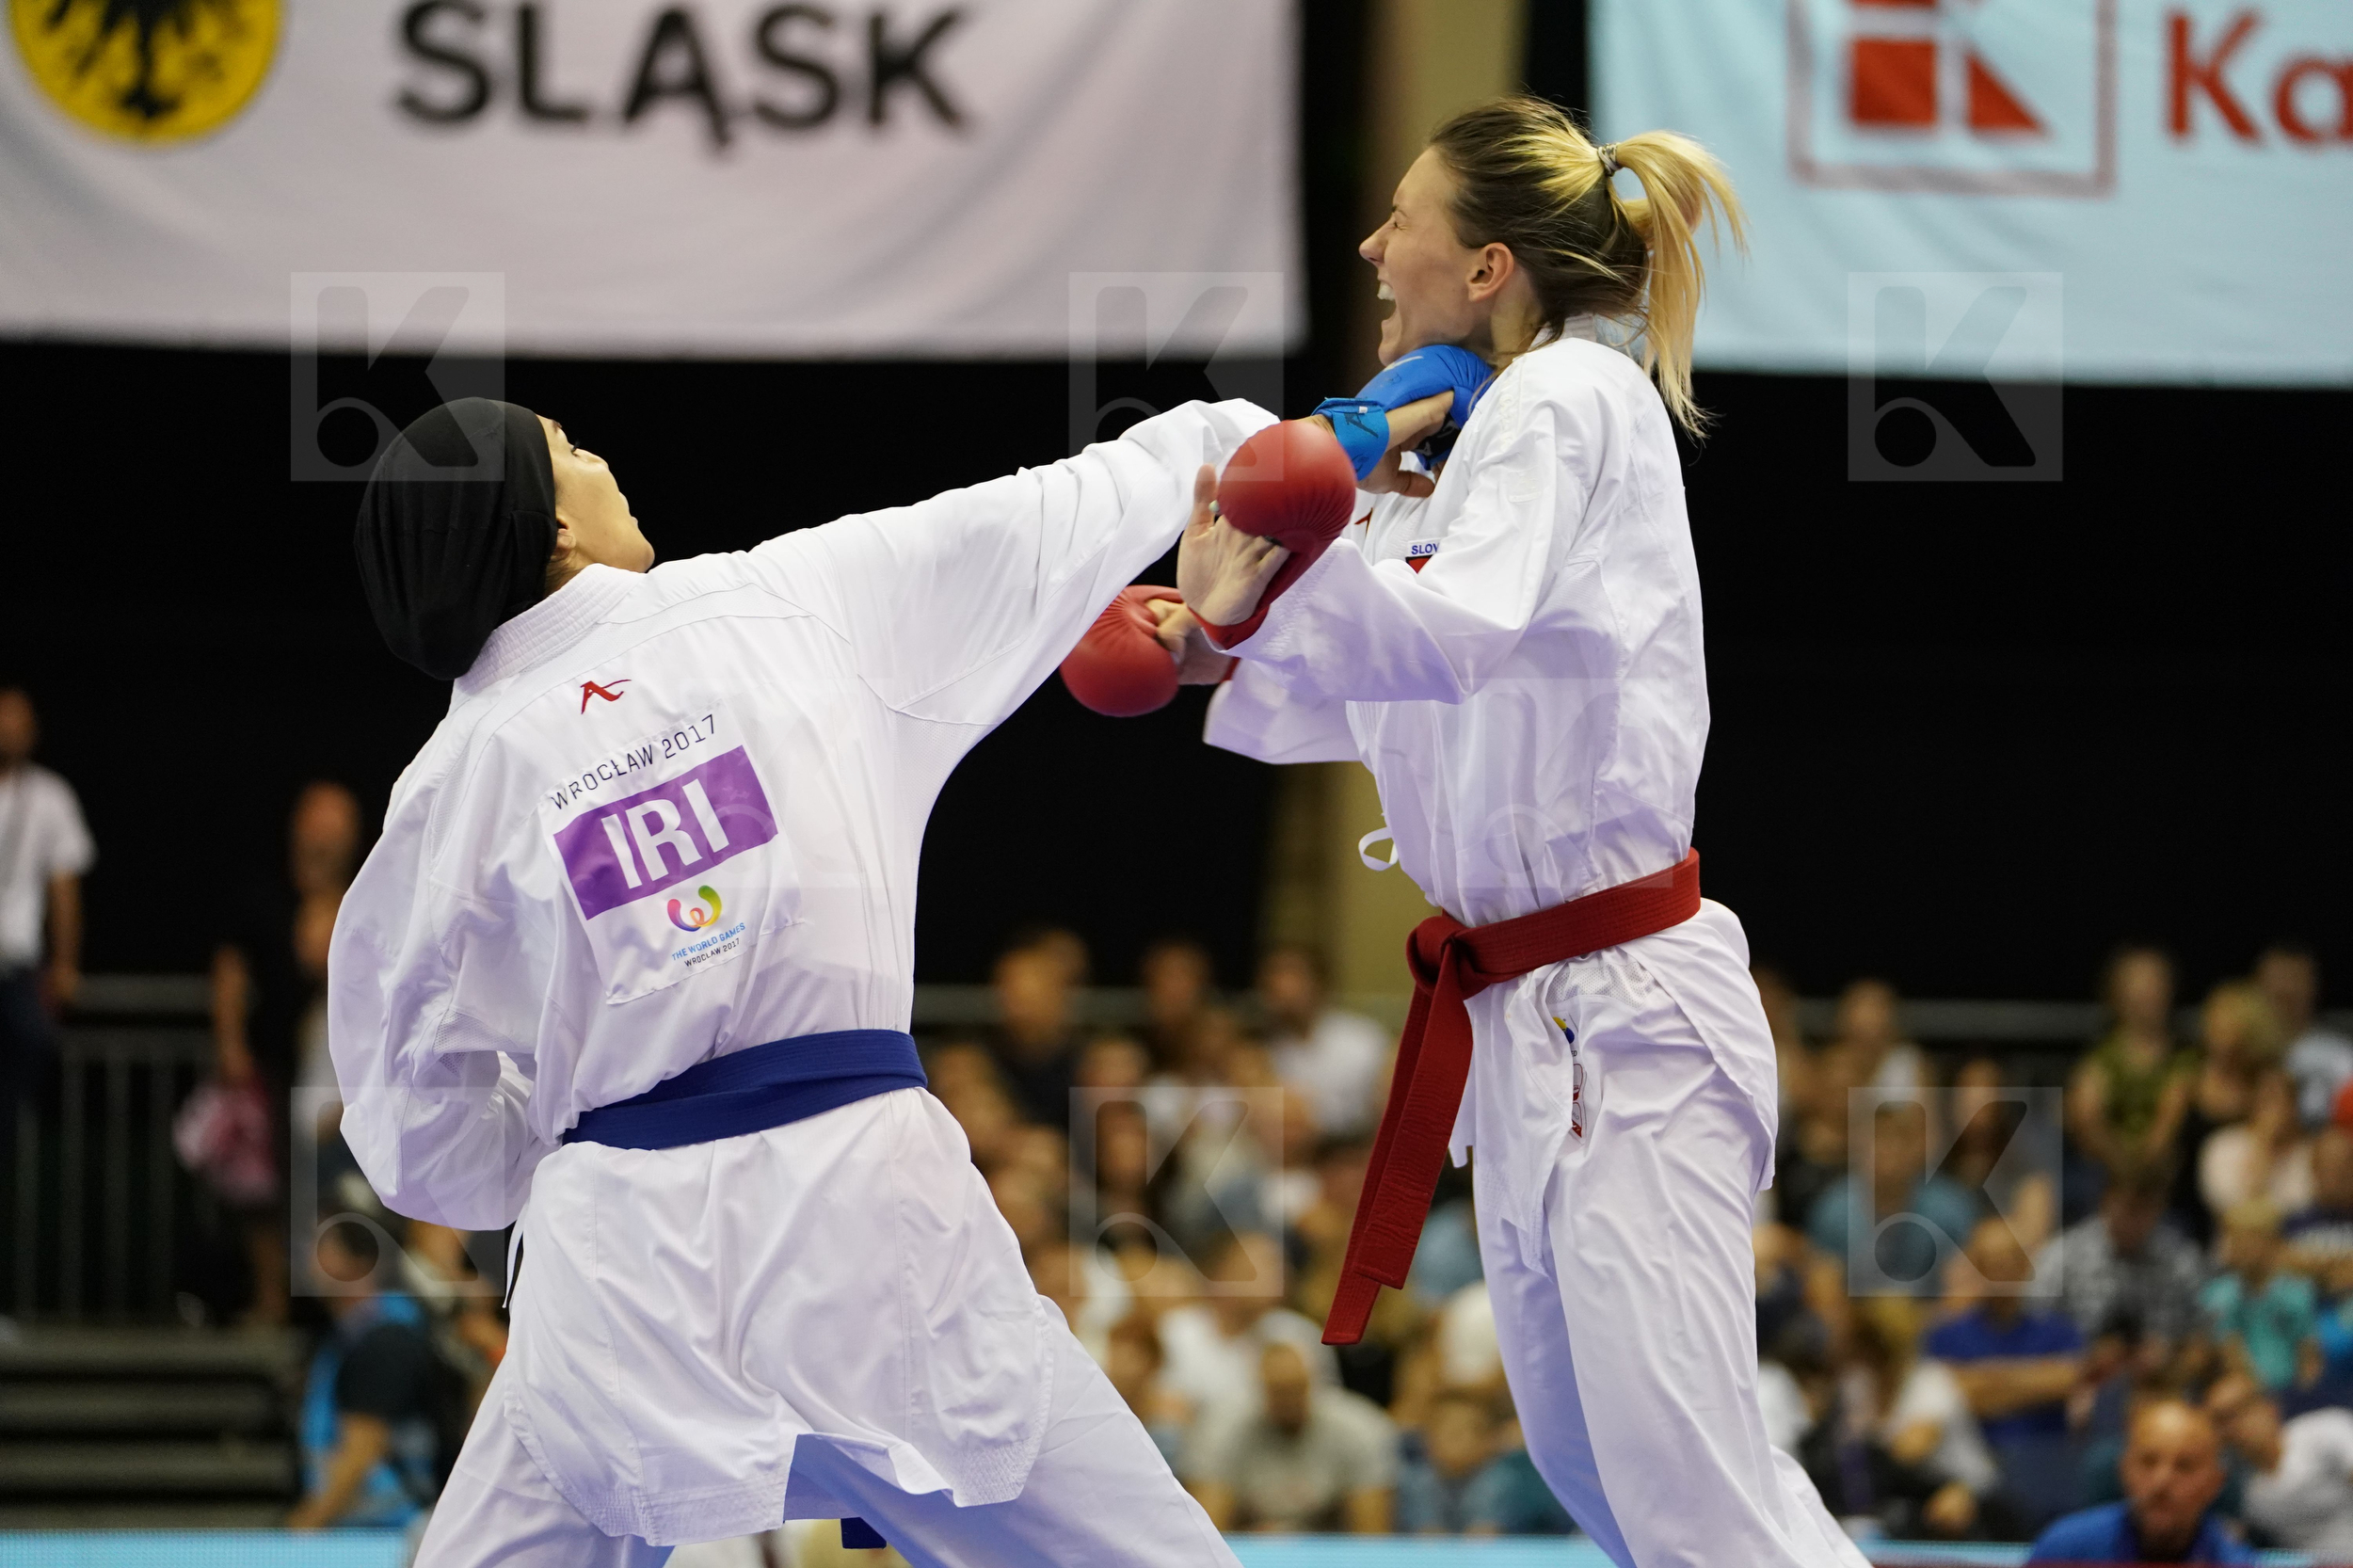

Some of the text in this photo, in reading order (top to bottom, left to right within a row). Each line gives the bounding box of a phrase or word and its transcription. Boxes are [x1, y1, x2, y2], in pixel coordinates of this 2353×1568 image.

[2162, 11, 2353, 151] Ka
[662, 713, 715, 760] 2017
[600, 778, 730, 889] IRI
[671, 922, 745, 961] THE WORLD GAMES
[722, 937, 740, 952] 2017
